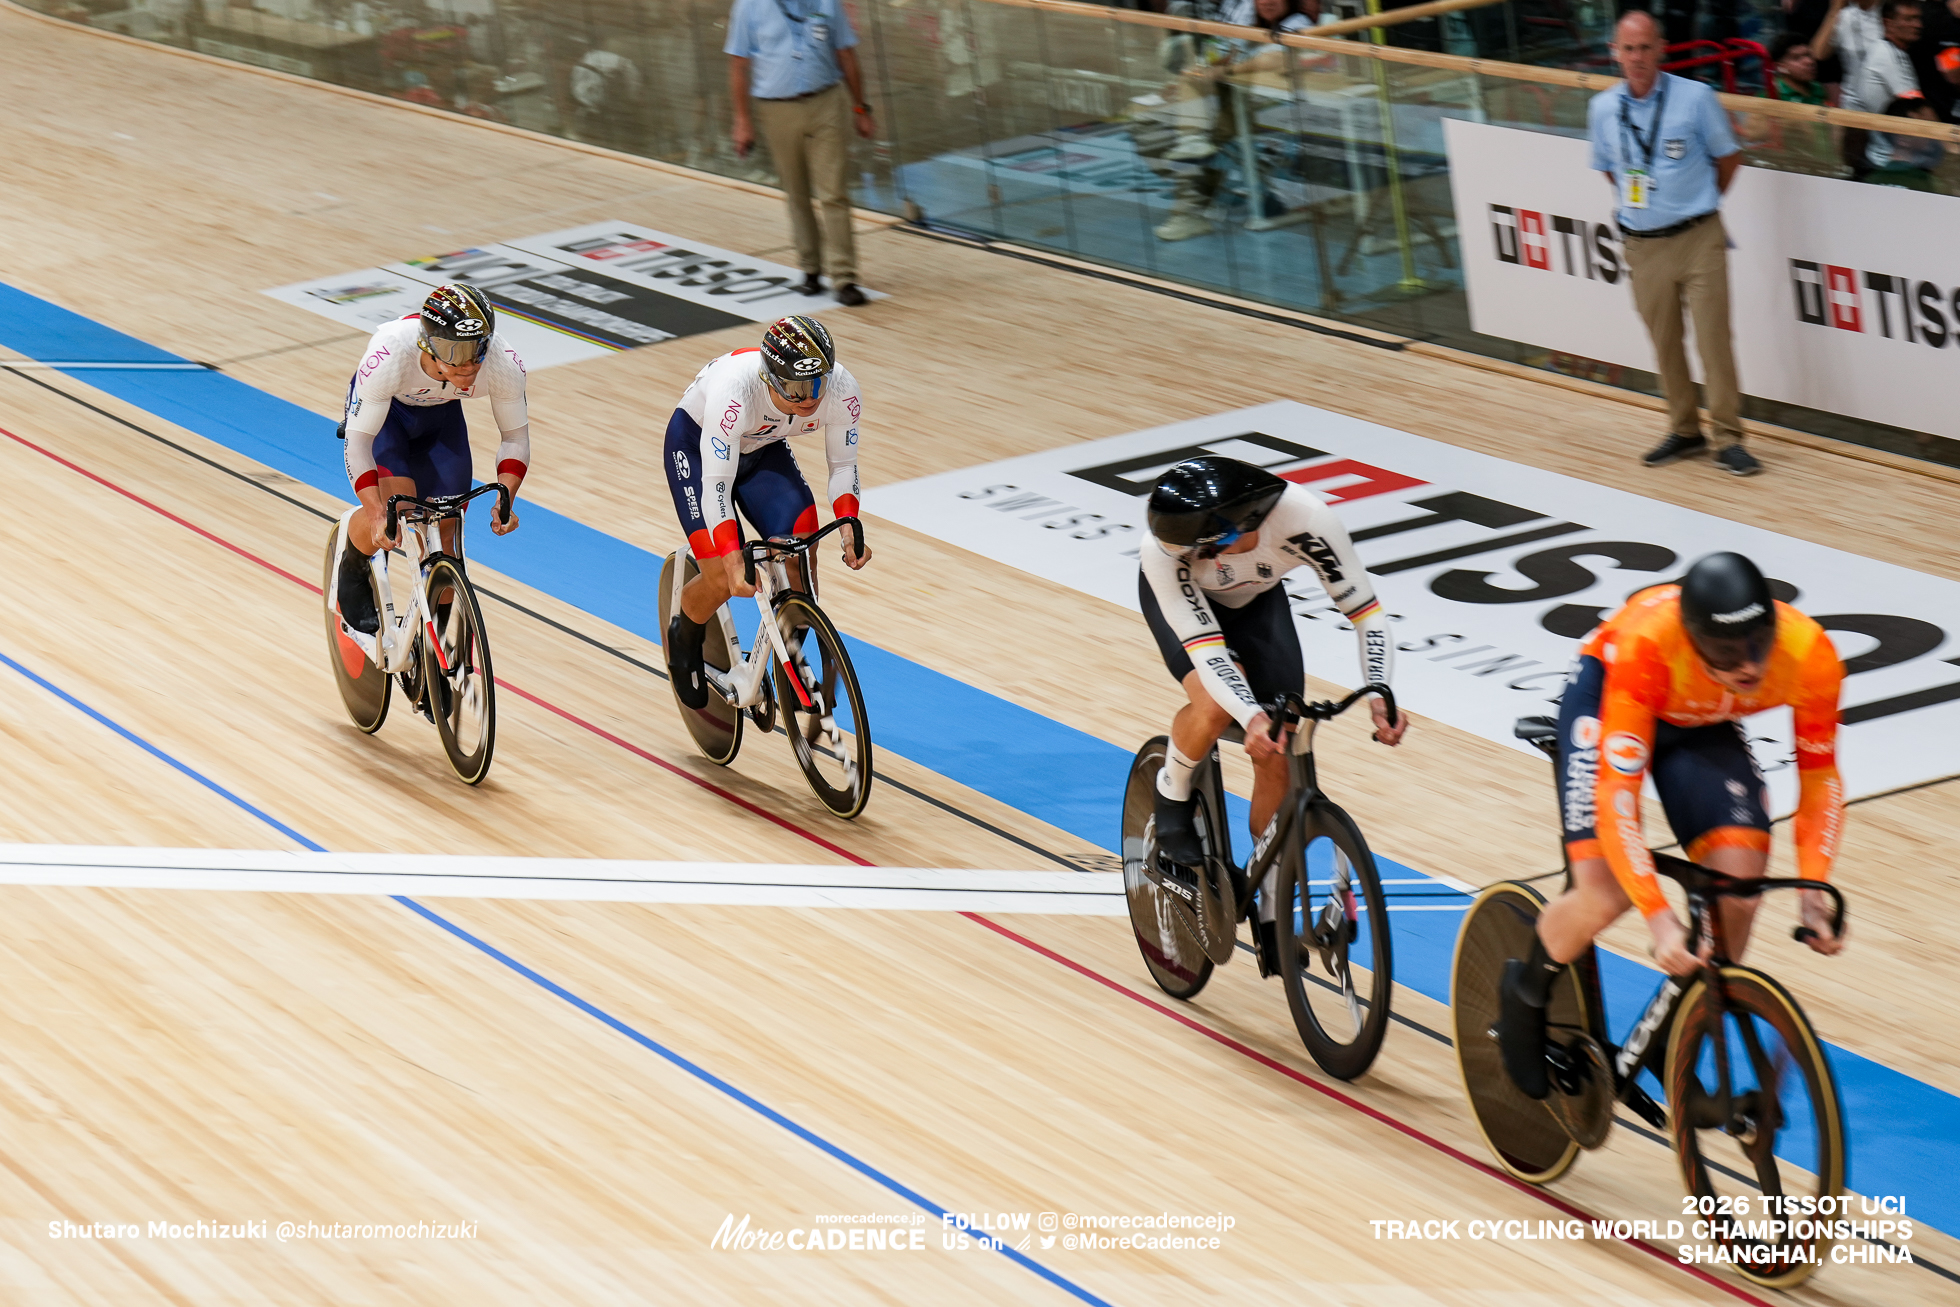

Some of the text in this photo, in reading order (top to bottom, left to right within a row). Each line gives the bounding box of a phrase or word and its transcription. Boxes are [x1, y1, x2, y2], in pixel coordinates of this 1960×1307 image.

[421, 308, 447, 326] abuto
[795, 368, 823, 377] Kabuto
[683, 486, 701, 519] SPEED
[718, 494, 727, 519] cyclers
[956, 483, 1137, 541] SWISS
[1285, 531, 1346, 584] KTM
[1396, 632, 1568, 704] SINC
